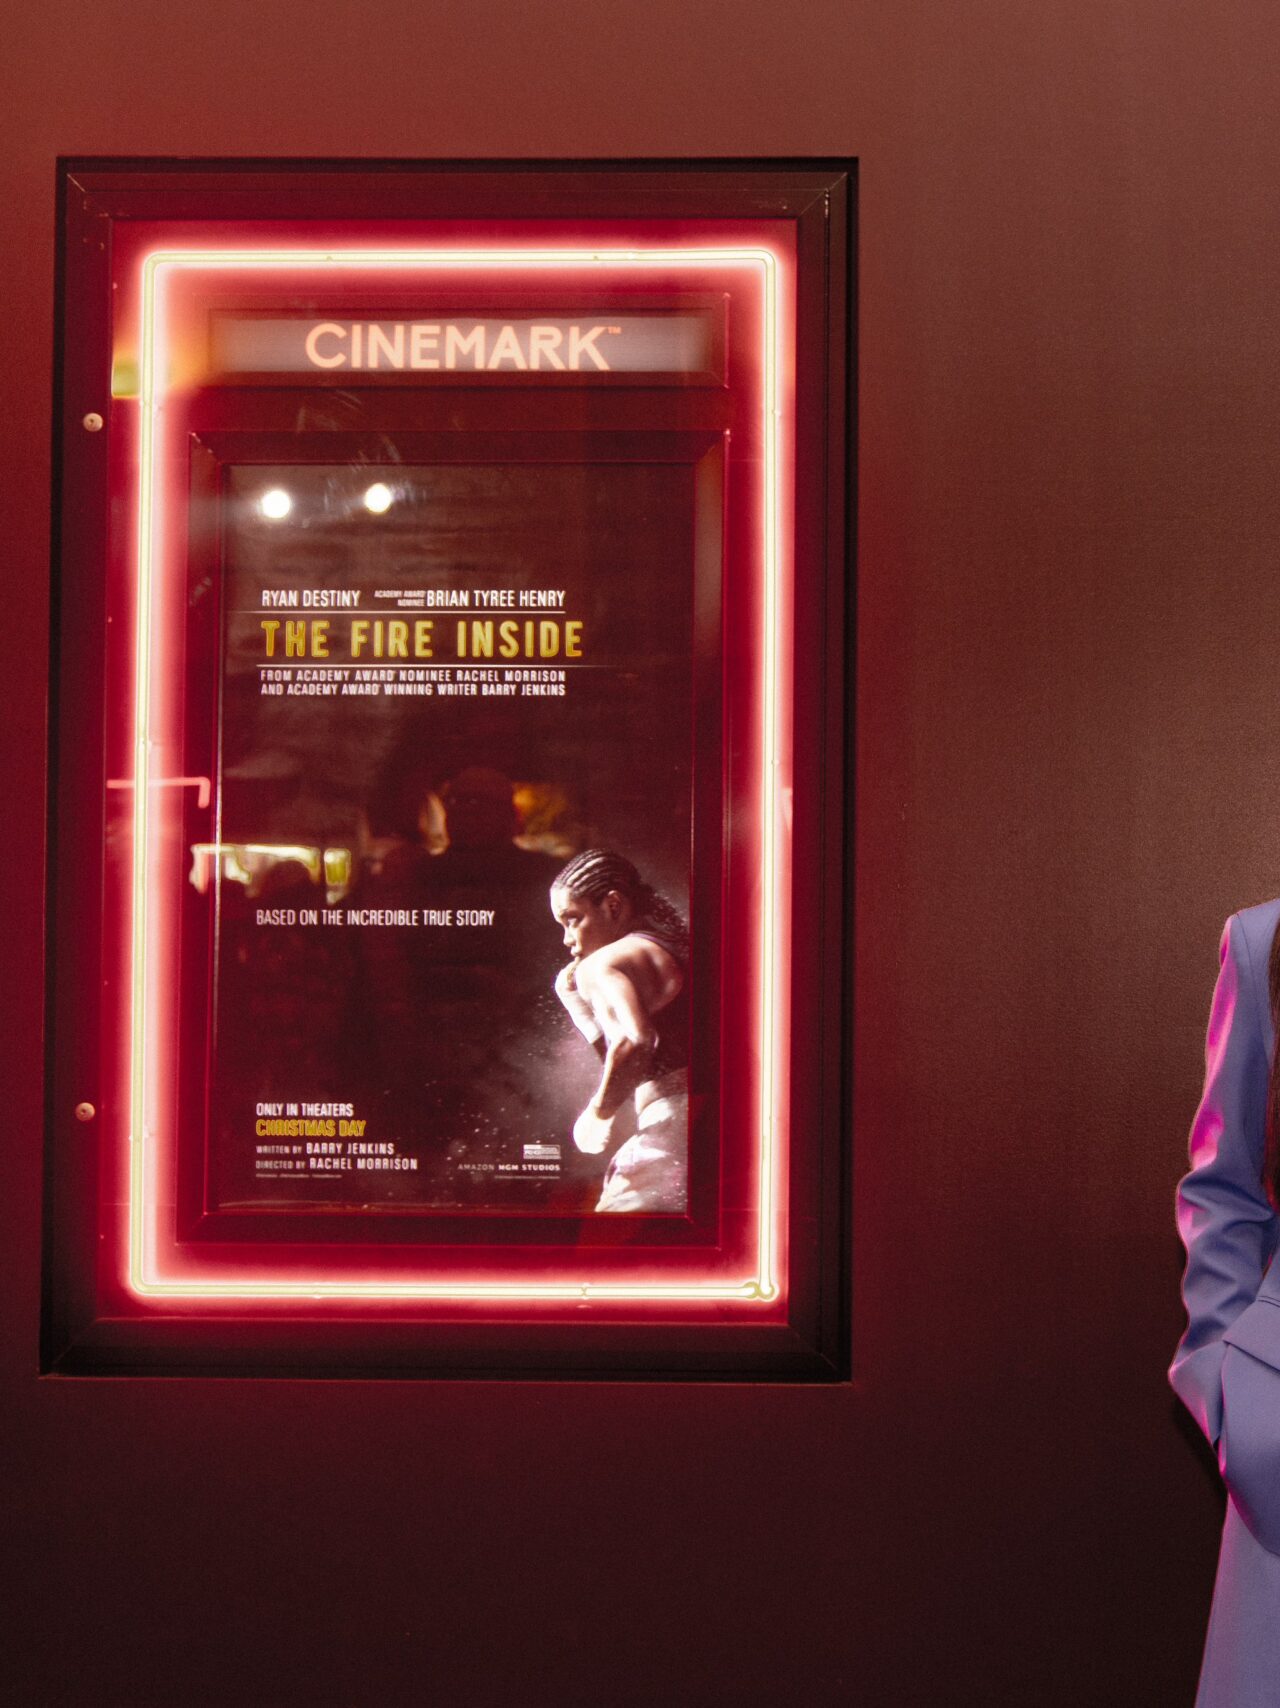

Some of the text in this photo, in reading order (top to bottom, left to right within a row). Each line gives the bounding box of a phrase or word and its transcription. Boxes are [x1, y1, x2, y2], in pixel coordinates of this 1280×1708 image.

[262, 590, 361, 607] RYAN DESTINY
[427, 590, 566, 607] BRIAN TYREE HENRY
[261, 620, 583, 658] THE FIRE INSIDE
[260, 670, 292, 682] FROM
[296, 670, 350, 682] ACADEMY
[400, 670, 451, 682] NOMINEE
[456, 670, 499, 682] RACHEL
[505, 670, 566, 682] MORRISON
[261, 683, 283, 696] AND
[287, 683, 338, 696] ACADEMY
[384, 683, 433, 696] WINNING
[437, 683, 477, 696] WRITER
[482, 683, 516, 696] BARRY
[521, 683, 566, 696] JENKINS
[256, 909, 495, 926] BASED ON THE INCREDIBLE TRUE STORY
[256, 1103, 354, 1117] ONLY IN THEATERS
[256, 1119, 366, 1137] CHRISTMAS DAY
[256, 1142, 395, 1155] WRITTEN BY BARRY JENKINS
[255, 1157, 418, 1170] DIRECTED BY RACHEL MORRISON
